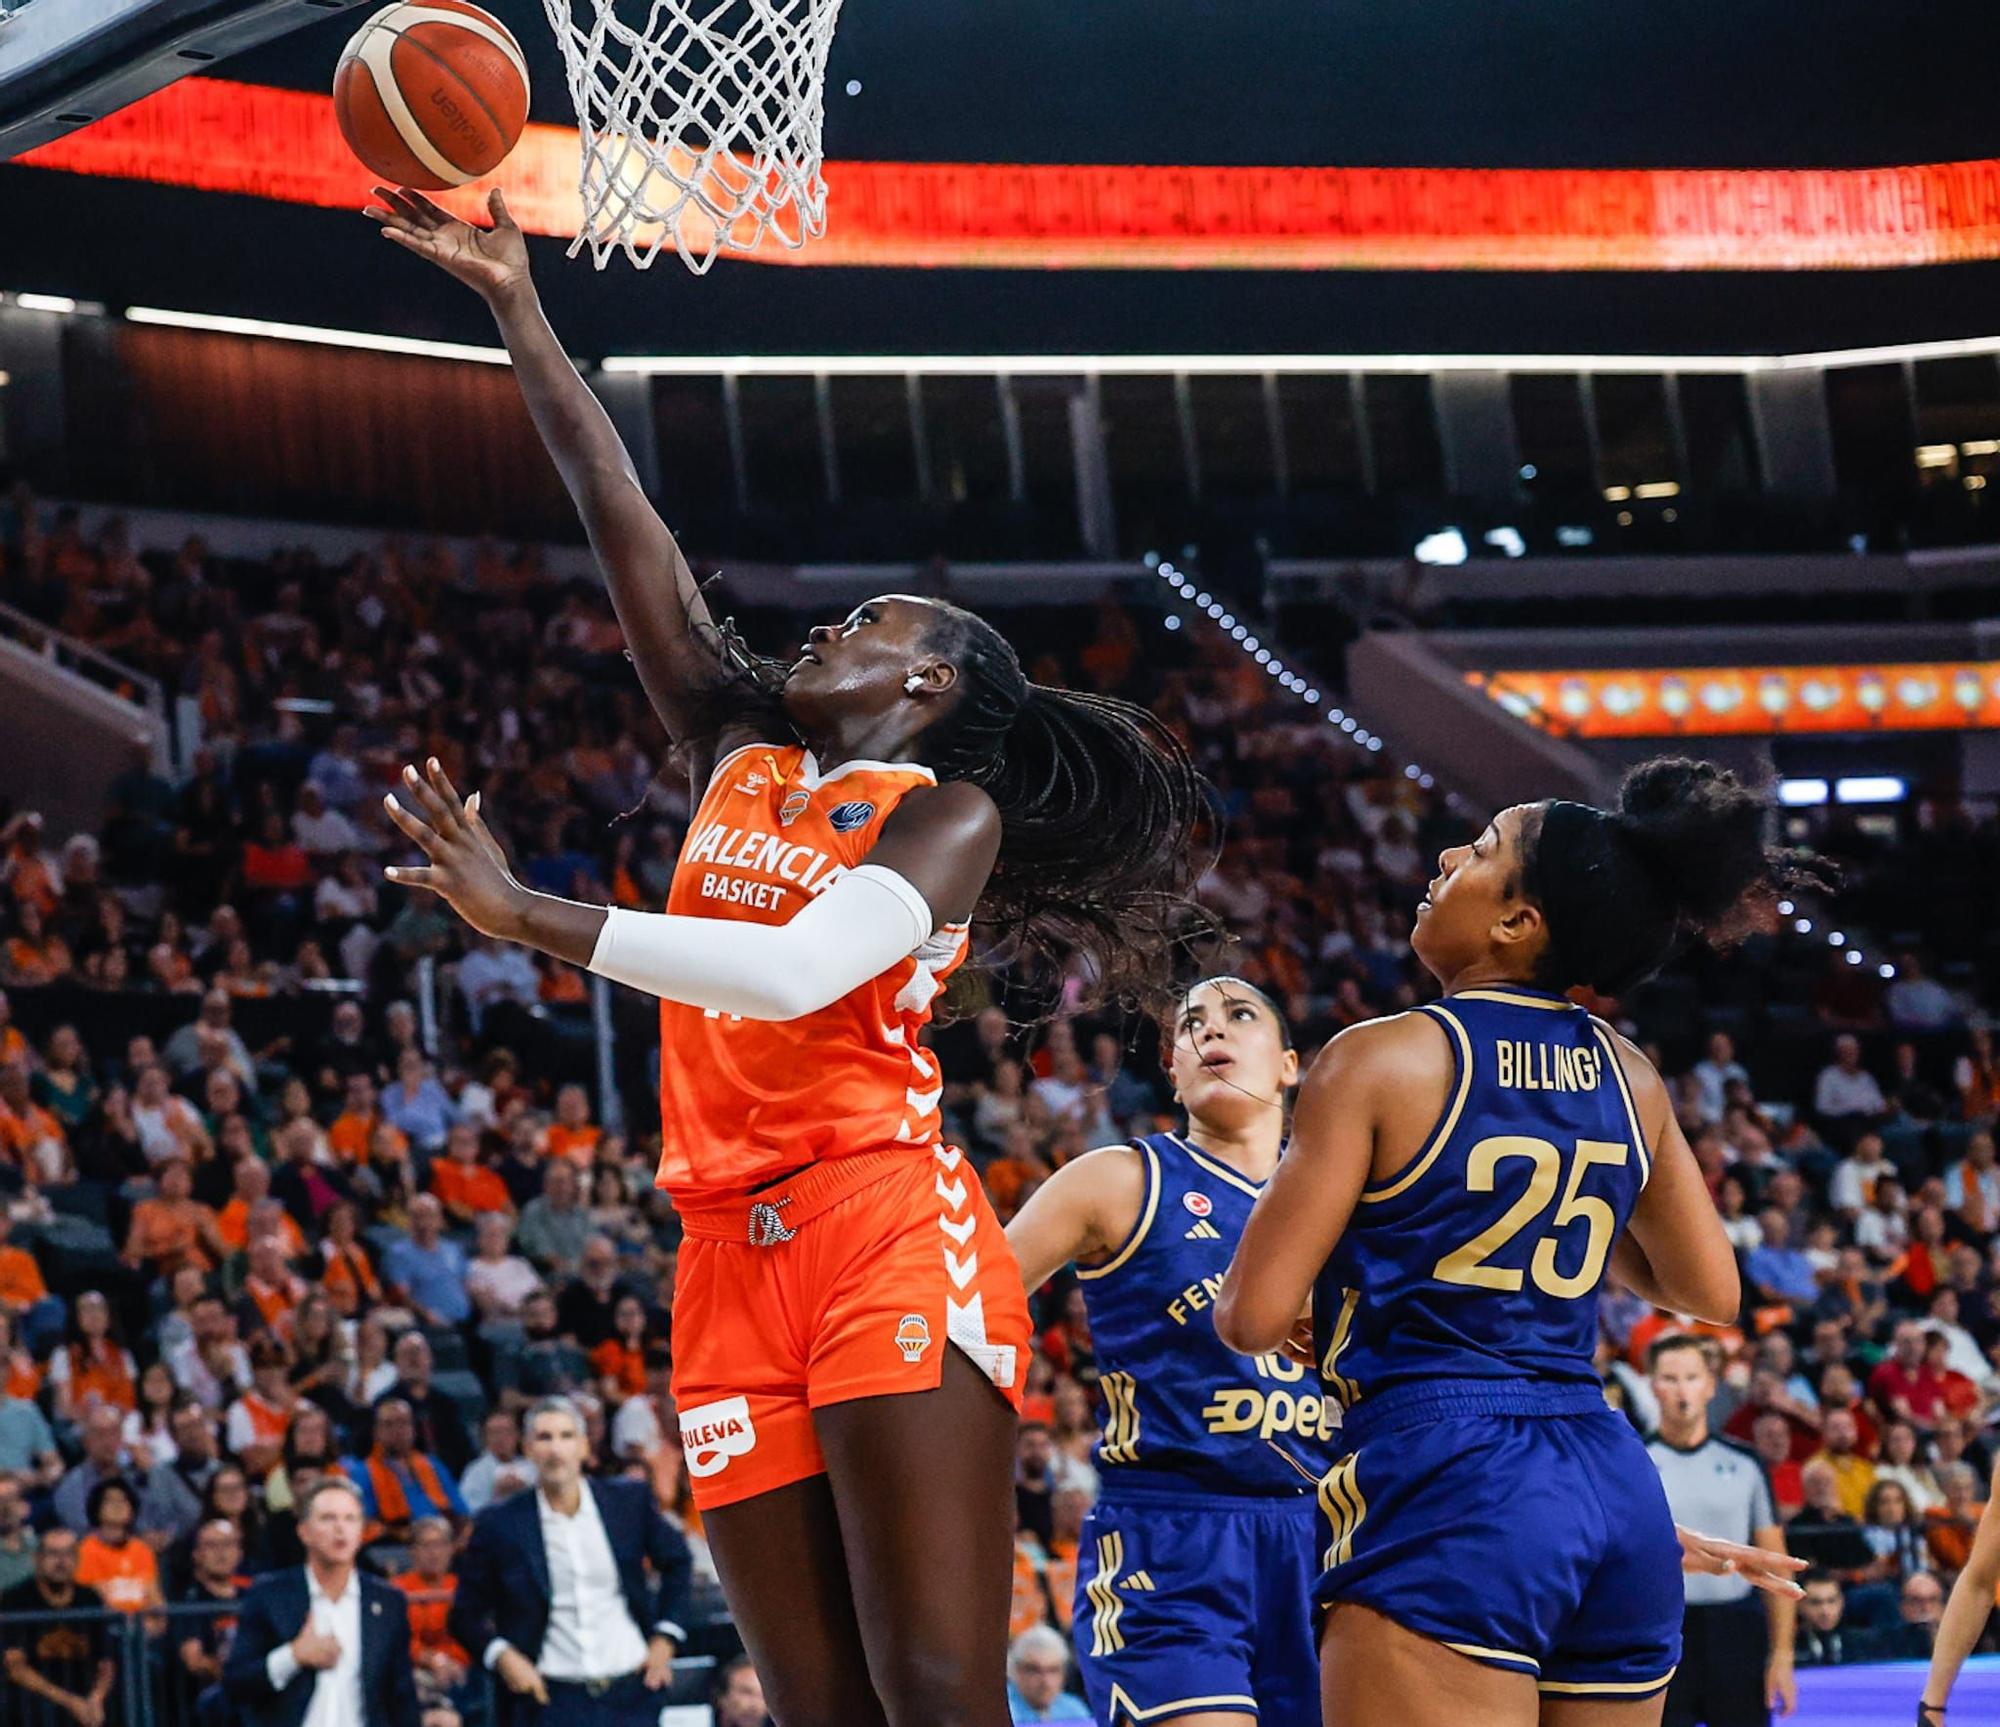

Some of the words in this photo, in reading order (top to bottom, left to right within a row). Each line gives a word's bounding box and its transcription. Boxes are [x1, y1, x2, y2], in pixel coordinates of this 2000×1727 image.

[431, 87, 488, 155] molten
[684, 823, 847, 895] VALENCIA
[701, 872, 787, 911] BASKET
[1433, 1136, 1629, 1299] 25
[681, 1417, 744, 1449] ULEVA
